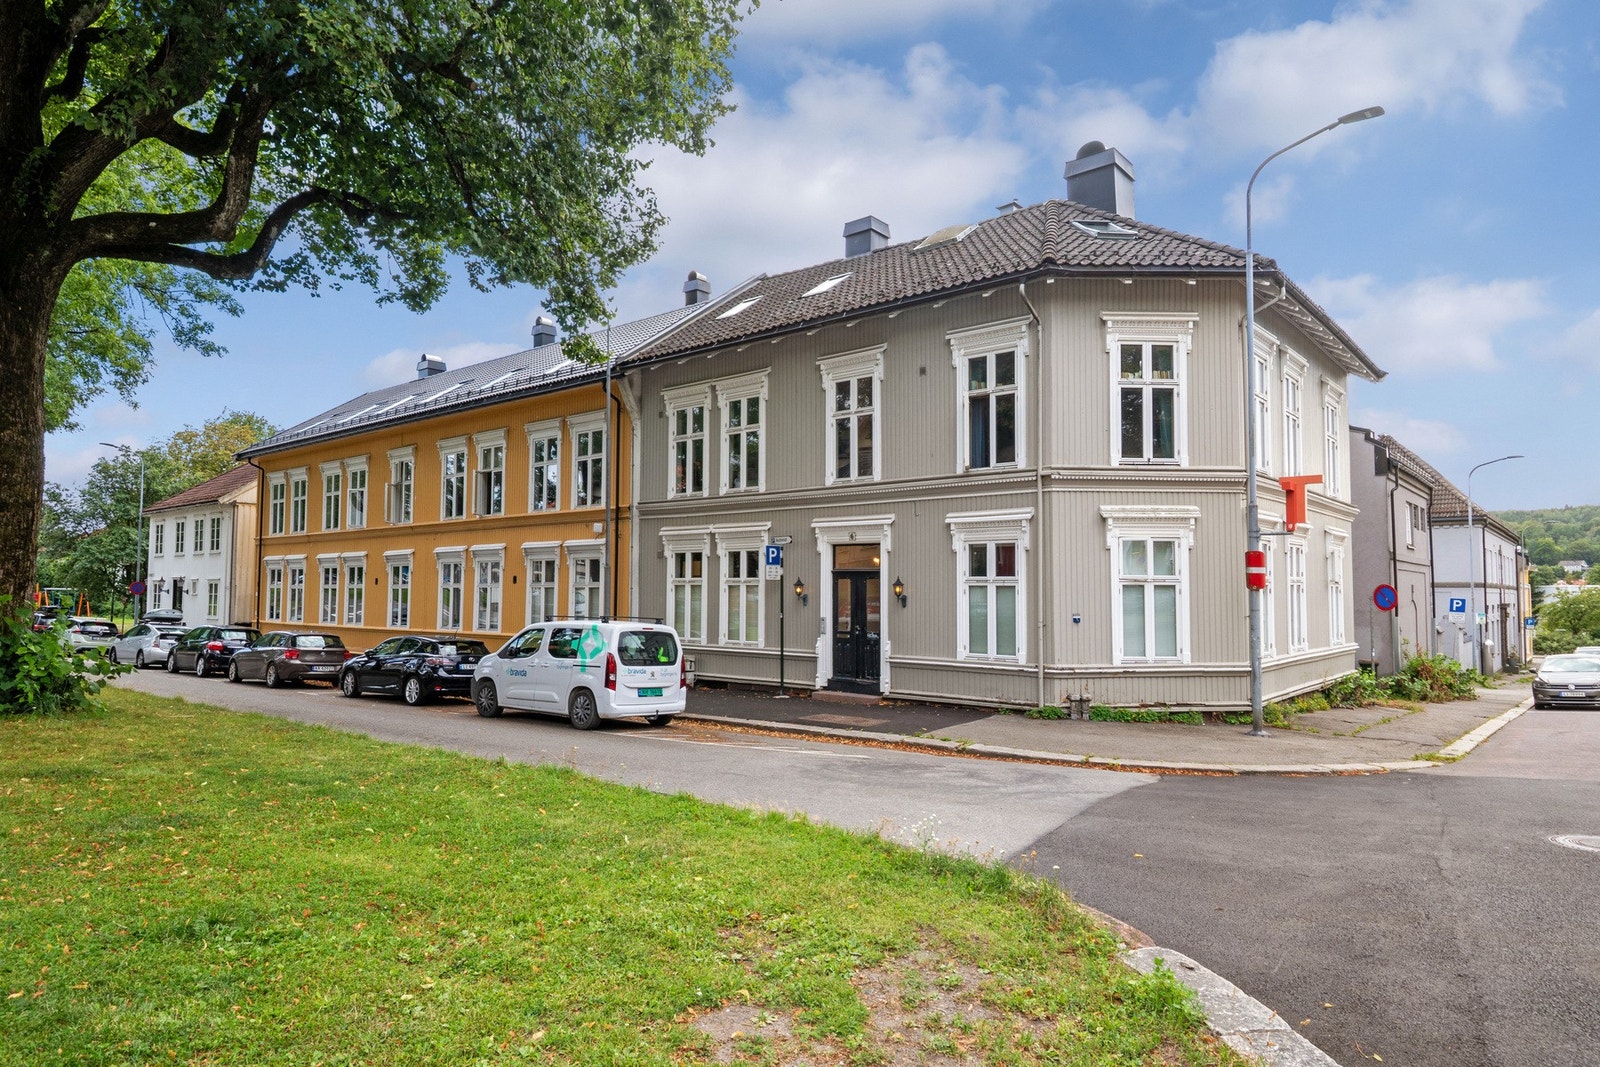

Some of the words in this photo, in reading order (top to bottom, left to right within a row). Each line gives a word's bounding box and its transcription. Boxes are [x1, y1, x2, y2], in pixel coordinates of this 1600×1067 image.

[769, 548, 777, 563] P
[1453, 600, 1462, 611] P
[510, 667, 527, 677] bravida
[627, 667, 647, 675] bravida
